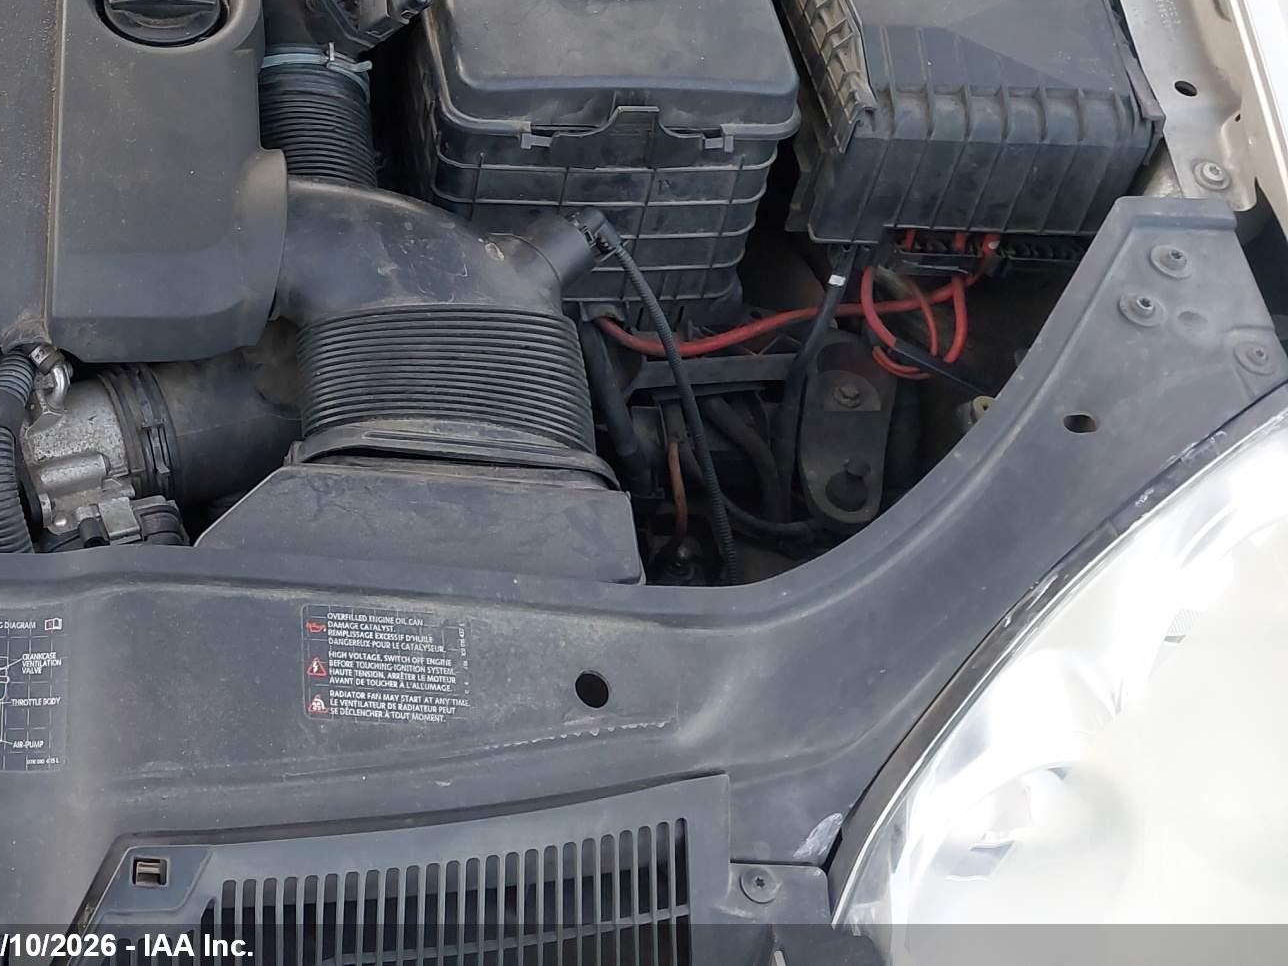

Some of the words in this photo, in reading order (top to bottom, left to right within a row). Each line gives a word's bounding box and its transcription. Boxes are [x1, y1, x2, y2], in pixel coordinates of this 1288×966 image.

[4, 620, 36, 629] DIAGRAM
[327, 613, 367, 622] OVERFILLED
[369, 615, 394, 624] ENGINE
[395, 617, 407, 625] OIL
[408, 618, 424, 626] CAN
[327, 621, 359, 630] DAMAGE
[360, 623, 396, 633] CATALYST.
[327, 629, 374, 639] REMPLISSAGE
[375, 632, 405, 641] EXCESSIF
[328, 637, 371, 648] DANGEREUX
[372, 640, 391, 649] POUR
[392, 641, 400, 650] LE
[401, 642, 446, 653] CATALYSEUR.
[22, 652, 57, 660] CRANKCASE
[22, 658, 62, 667] VENTILATION
[328, 650, 348, 659] HIGH
[348, 652, 383, 662] VOLTAGE,
[383, 655, 411, 664] SWITCH
[411, 656, 425, 664] OFF
[426, 657, 452, 667] ENGINE
[21, 666, 42, 674] VALVE
[328, 659, 354, 668] BEFORE
[355, 661, 393, 671] TOUCHING
[393, 664, 426, 673] IGNITION
[426, 666, 456, 675] SYSTEM.
[329, 668, 353, 677] HAUTE
[354, 669, 386, 679] TENSION,
[417, 674, 426, 682] LE
[426, 674, 457, 684] MOTEUR
[329, 676, 354, 685] AVANT
[355, 678, 365, 686] DE
[366, 678, 398, 688] TOUCHER
[406, 681, 453, 692] L'ALLUMAGE.
[12, 698, 42, 706] THROTTLE
[42, 696, 61, 705] BODY
[329, 689, 366, 700] RADIATOR
[367, 692, 382, 700] FAN
[383, 694, 400, 702] MAY
[401, 695, 422, 703] START
[423, 696, 434, 704] AT
[435, 697, 450, 705] ANY
[451, 698, 471, 707] TIME.
[329, 698, 338, 707] LE
[339, 699, 386, 710] VENTILATEUR
[387, 702, 397, 710] DE
[397, 703, 438, 713] RADIATEUR
[438, 705, 457, 714] PEUT
[330, 707, 339, 715] SE
[339, 707, 384, 718] DÉCLENCHER
[390, 711, 411, 720] TOUT
[411, 713, 447, 723] MOMENT.
